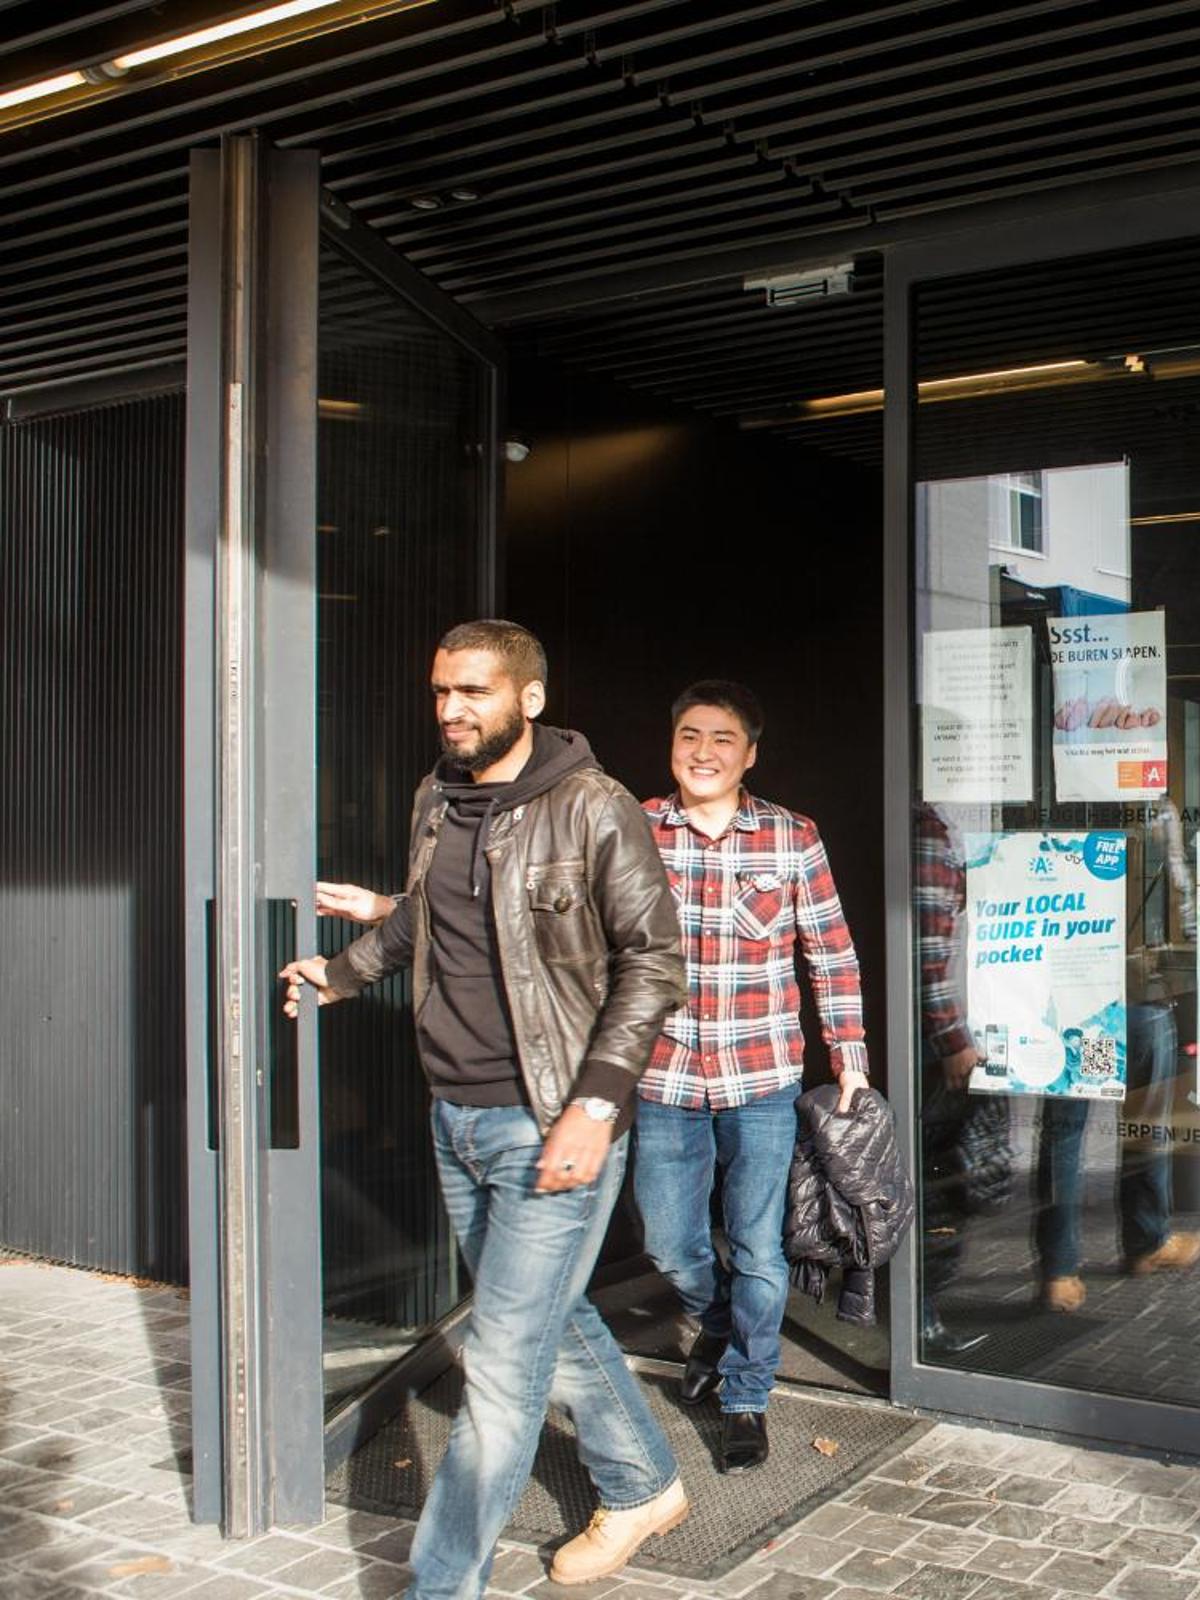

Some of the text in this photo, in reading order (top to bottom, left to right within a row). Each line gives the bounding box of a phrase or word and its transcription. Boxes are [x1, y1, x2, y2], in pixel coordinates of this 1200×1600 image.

[1051, 651, 1065, 663] DE
[1068, 648, 1108, 662] BUREN
[1096, 841, 1121, 853] FREE
[1095, 854, 1119, 866] APP
[975, 893, 1086, 918] Your LOCAL
[976, 917, 1116, 942] GUIDE in your
[975, 944, 1044, 969] pocket
